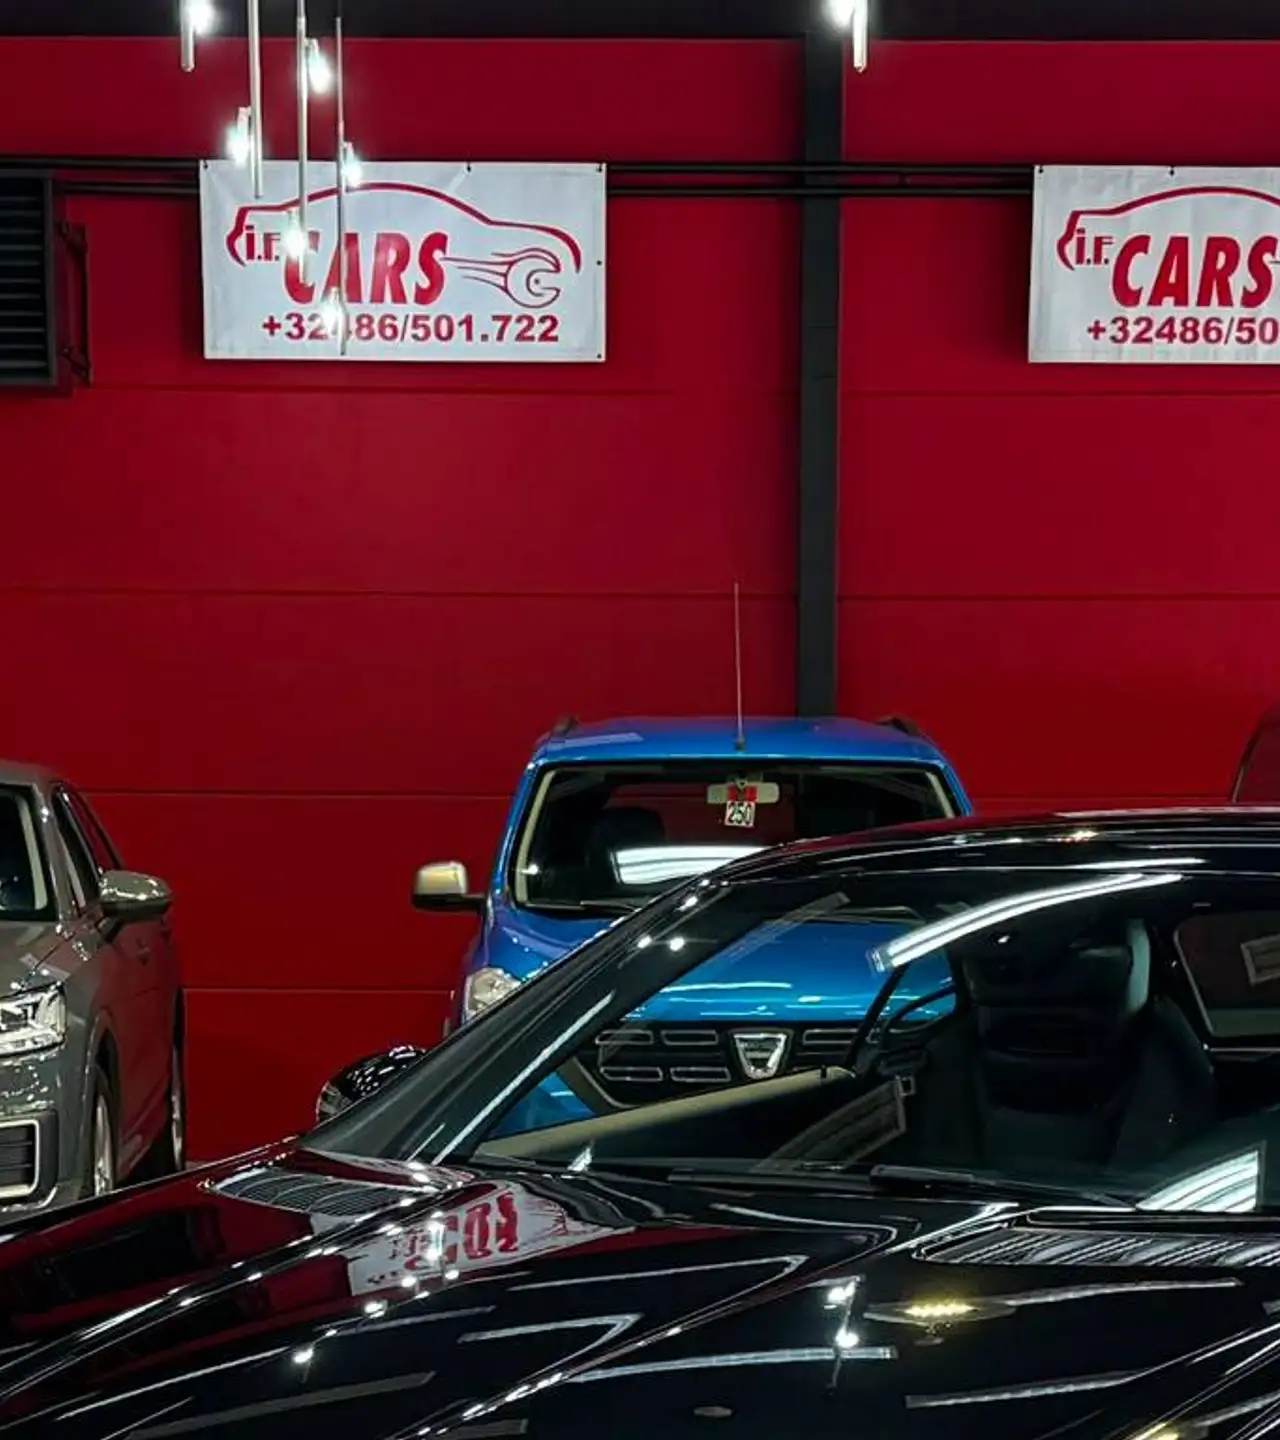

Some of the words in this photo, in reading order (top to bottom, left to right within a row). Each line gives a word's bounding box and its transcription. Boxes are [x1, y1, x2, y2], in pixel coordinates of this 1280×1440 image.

[284, 230, 449, 305] CARS
[1112, 235, 1279, 308] CARS
[262, 312, 560, 343] +3286/501.722
